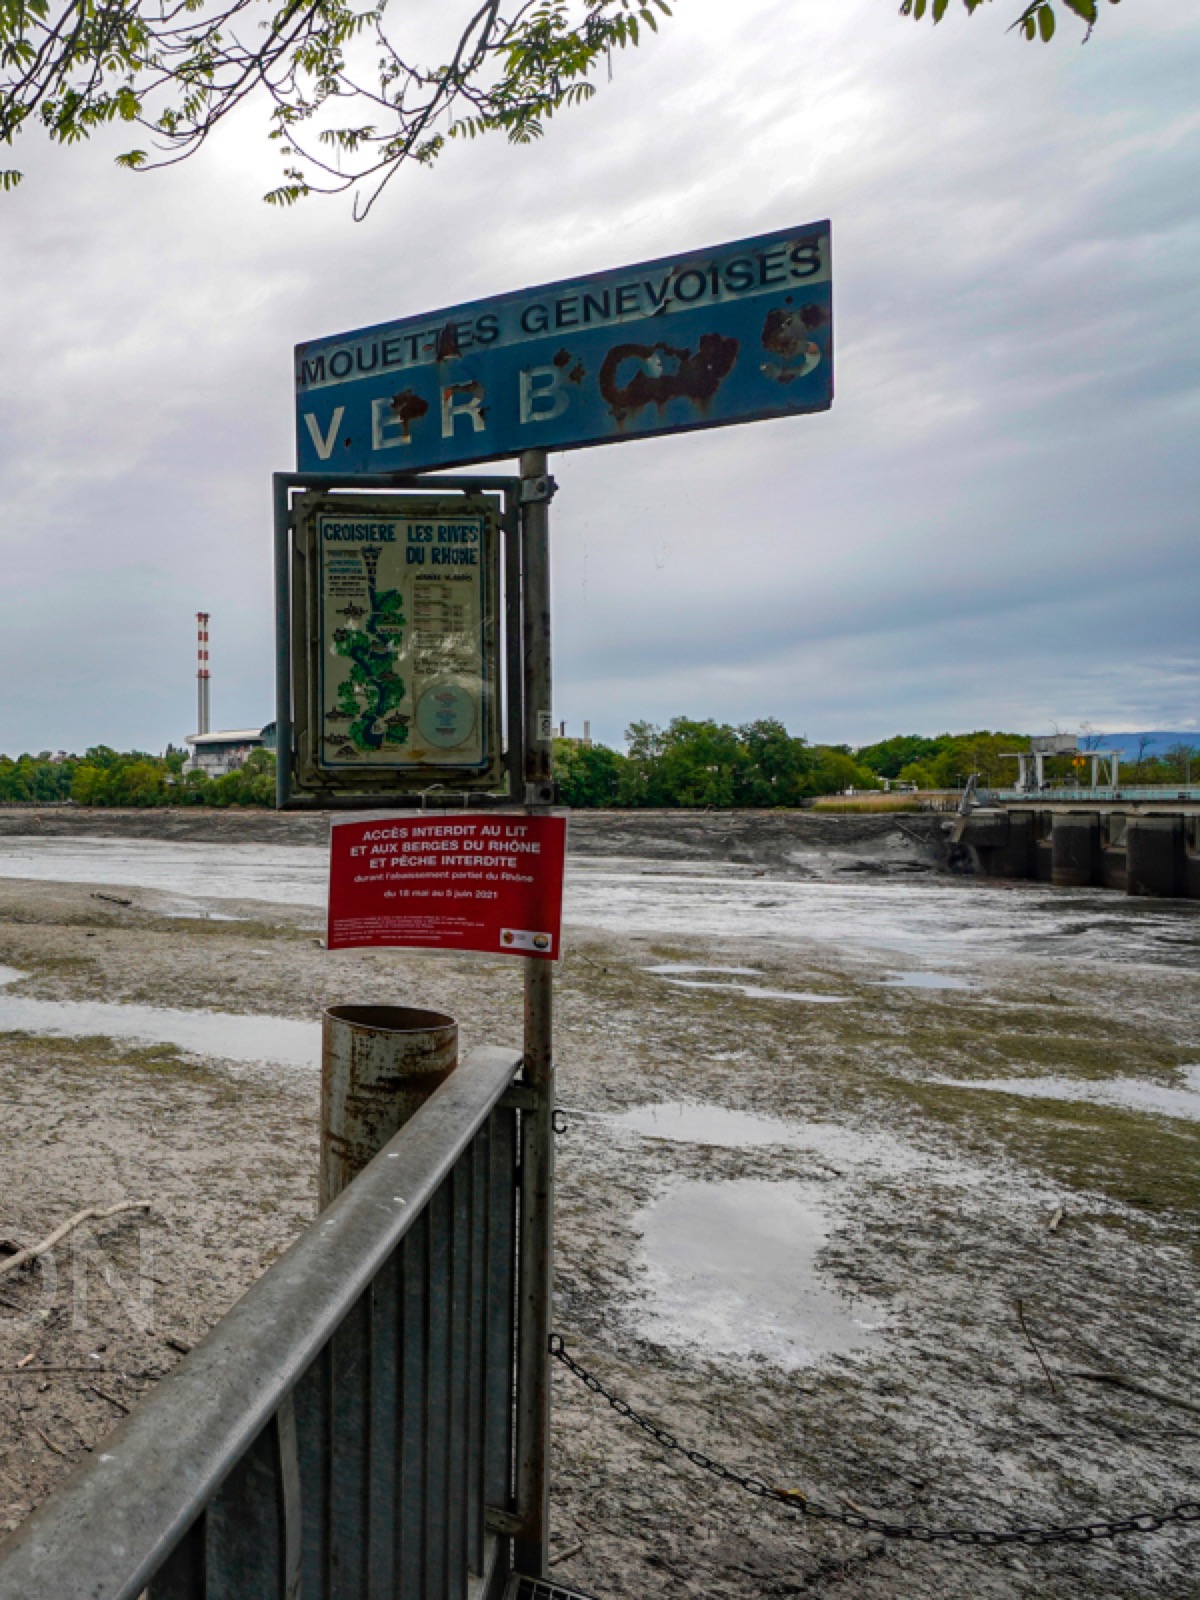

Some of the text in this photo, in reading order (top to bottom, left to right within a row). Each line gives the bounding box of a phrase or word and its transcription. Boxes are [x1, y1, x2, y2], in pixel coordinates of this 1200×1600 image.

[301, 244, 822, 385] MOUETTES GENEVOISES
[303, 303, 824, 461] VERBS
[324, 523, 479, 543] CROISIERE LES RIVES
[405, 547, 425, 565] DU
[362, 825, 528, 841] ACCÈS INTERDIT AU LIT
[350, 837, 541, 857] ET AUX BERGES DU RHÔNE
[369, 853, 517, 869] ET PÊCHE INTERDITE
[354, 873, 383, 883] durant
[451, 870, 483, 882] partiel
[486, 872, 498, 881] du
[501, 872, 534, 883] Rhône
[383, 889, 396, 898] du
[412, 889, 429, 898] mai
[454, 889, 473, 900] juin
[475, 889, 498, 899] 2021
